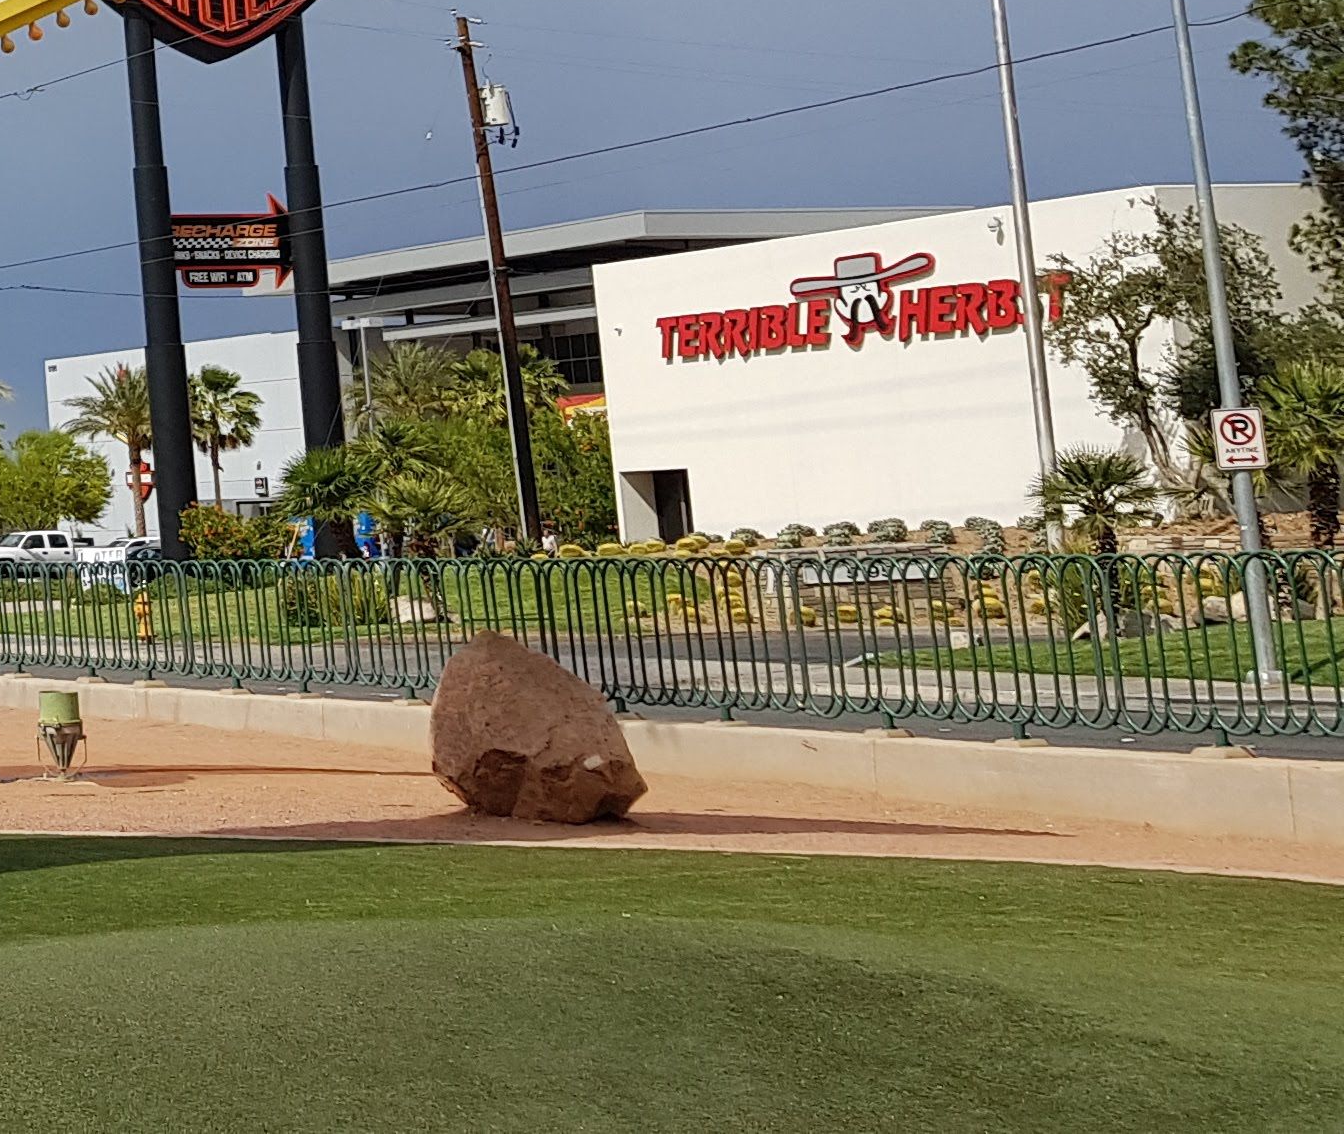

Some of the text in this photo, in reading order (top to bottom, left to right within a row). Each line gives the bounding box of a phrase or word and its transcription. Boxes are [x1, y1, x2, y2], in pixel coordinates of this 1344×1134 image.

[172, 224, 278, 237] RECHARGE
[189, 271, 209, 282] FREE
[237, 271, 253, 281] ATM
[656, 272, 1070, 359] TERRIBLE HERBT
